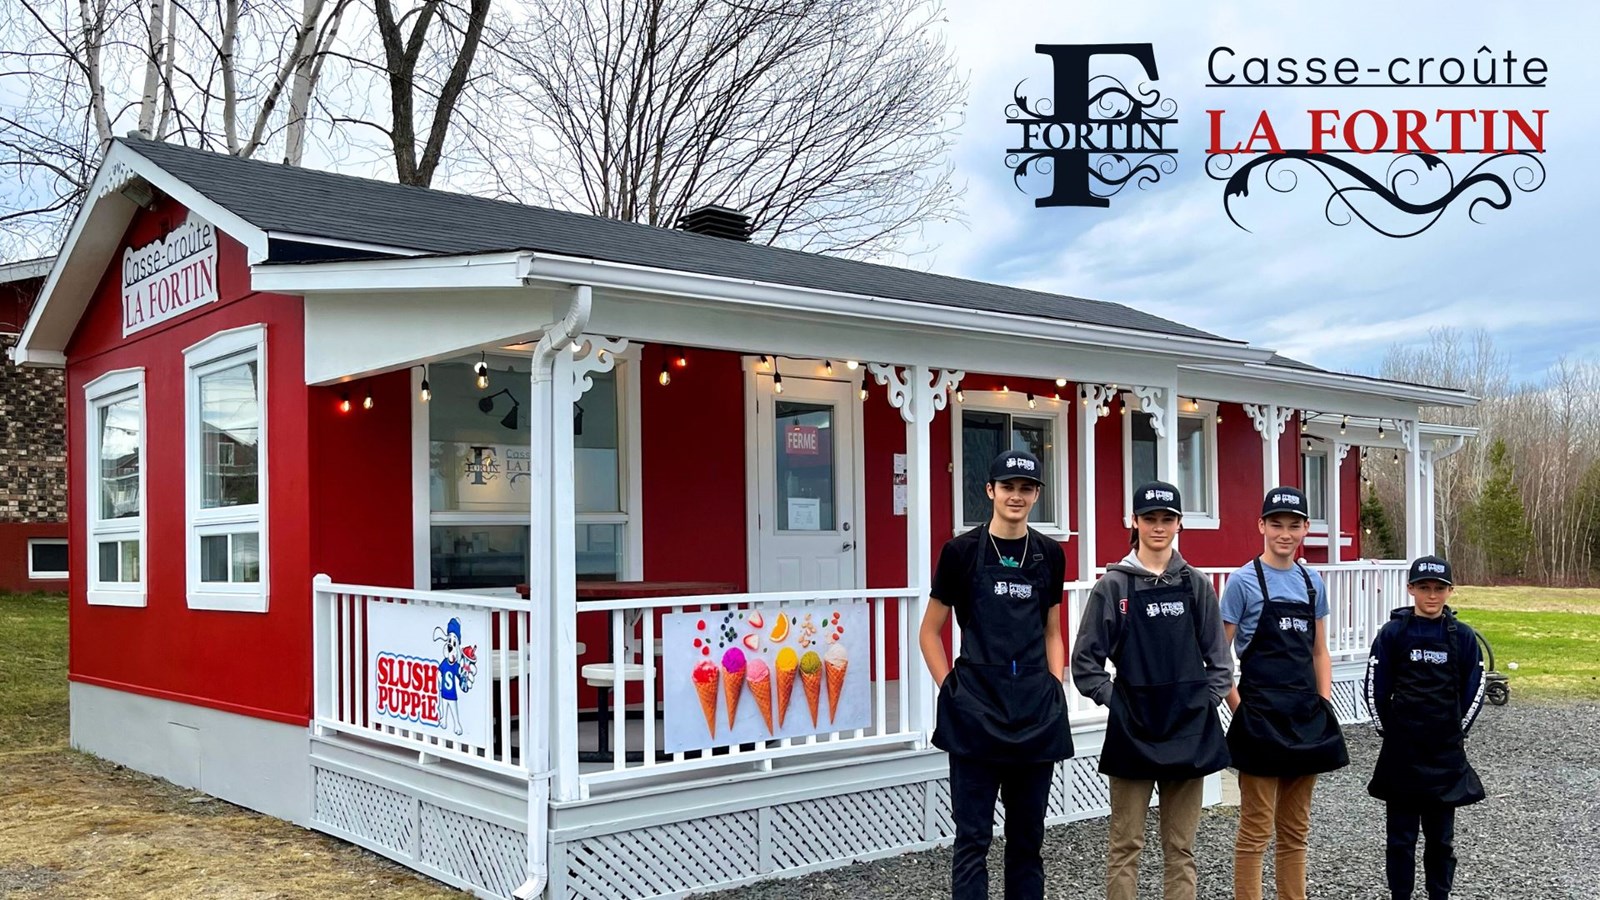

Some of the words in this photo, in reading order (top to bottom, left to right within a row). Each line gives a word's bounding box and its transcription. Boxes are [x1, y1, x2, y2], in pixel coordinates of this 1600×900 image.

[124, 221, 212, 286] Casse-croûte
[125, 289, 145, 329] LA
[149, 254, 214, 319] FORTIN
[787, 430, 816, 450] FERMÉ
[377, 656, 439, 695] SLUSH
